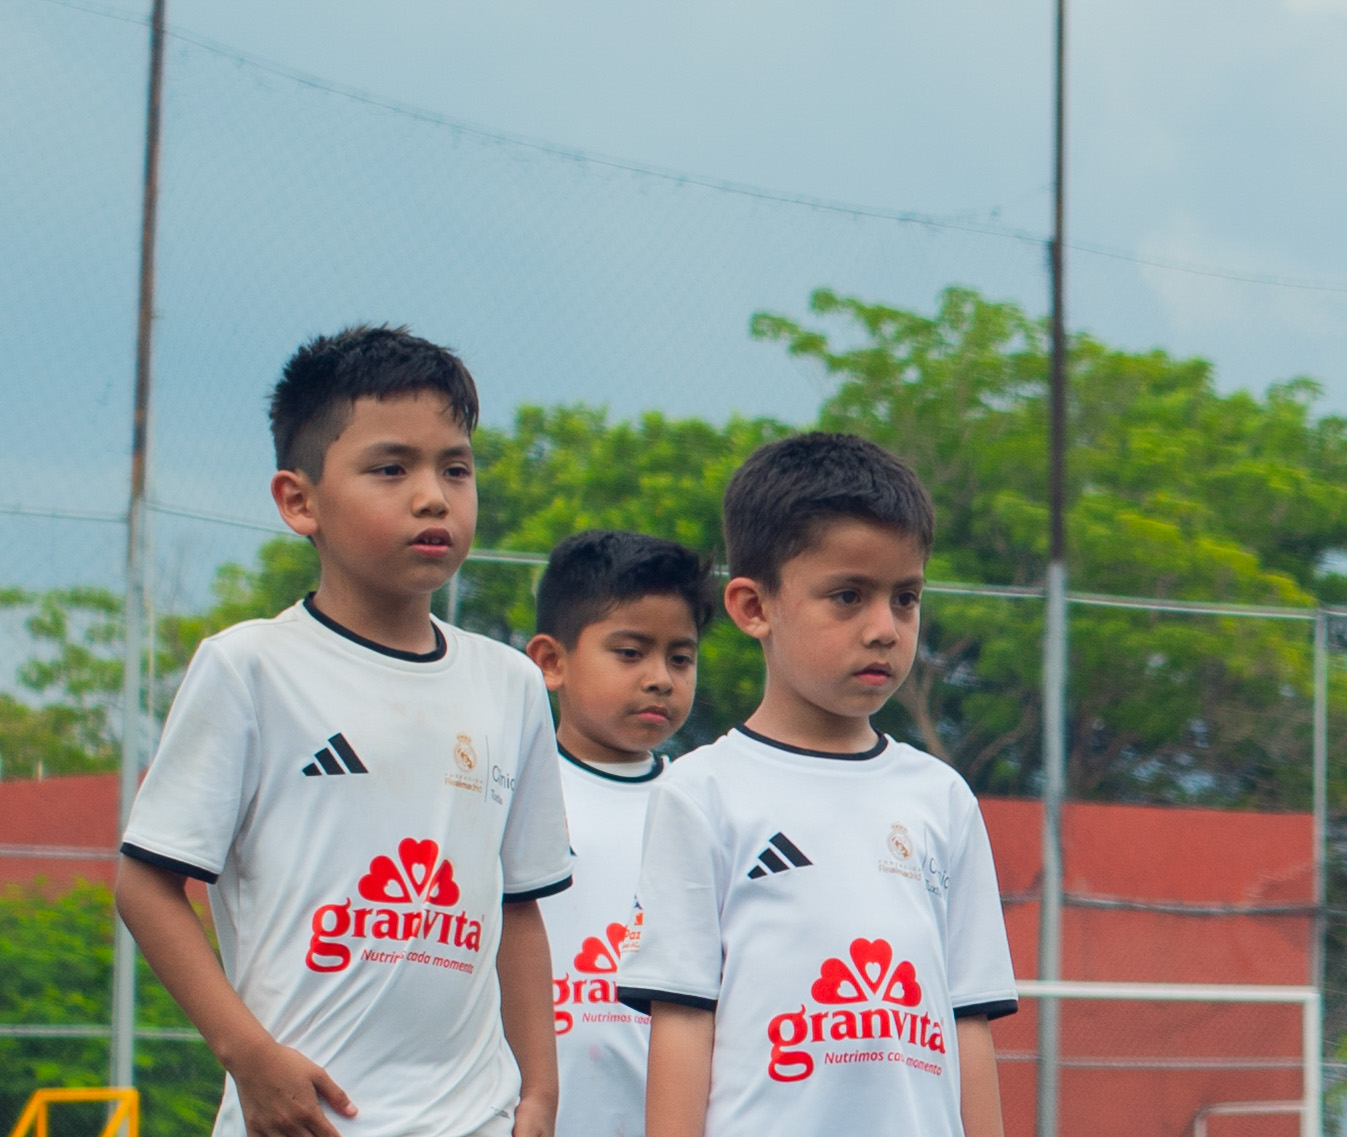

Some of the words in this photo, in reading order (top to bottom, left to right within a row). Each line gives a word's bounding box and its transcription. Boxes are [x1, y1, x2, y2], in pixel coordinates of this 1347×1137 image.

[305, 897, 480, 973] granvita
[406, 950, 431, 964] cada
[582, 1011, 632, 1023] Nutrimos
[767, 1004, 946, 1083] granvita
[824, 1050, 883, 1064] Nutrimos
[906, 1057, 942, 1076] momento
